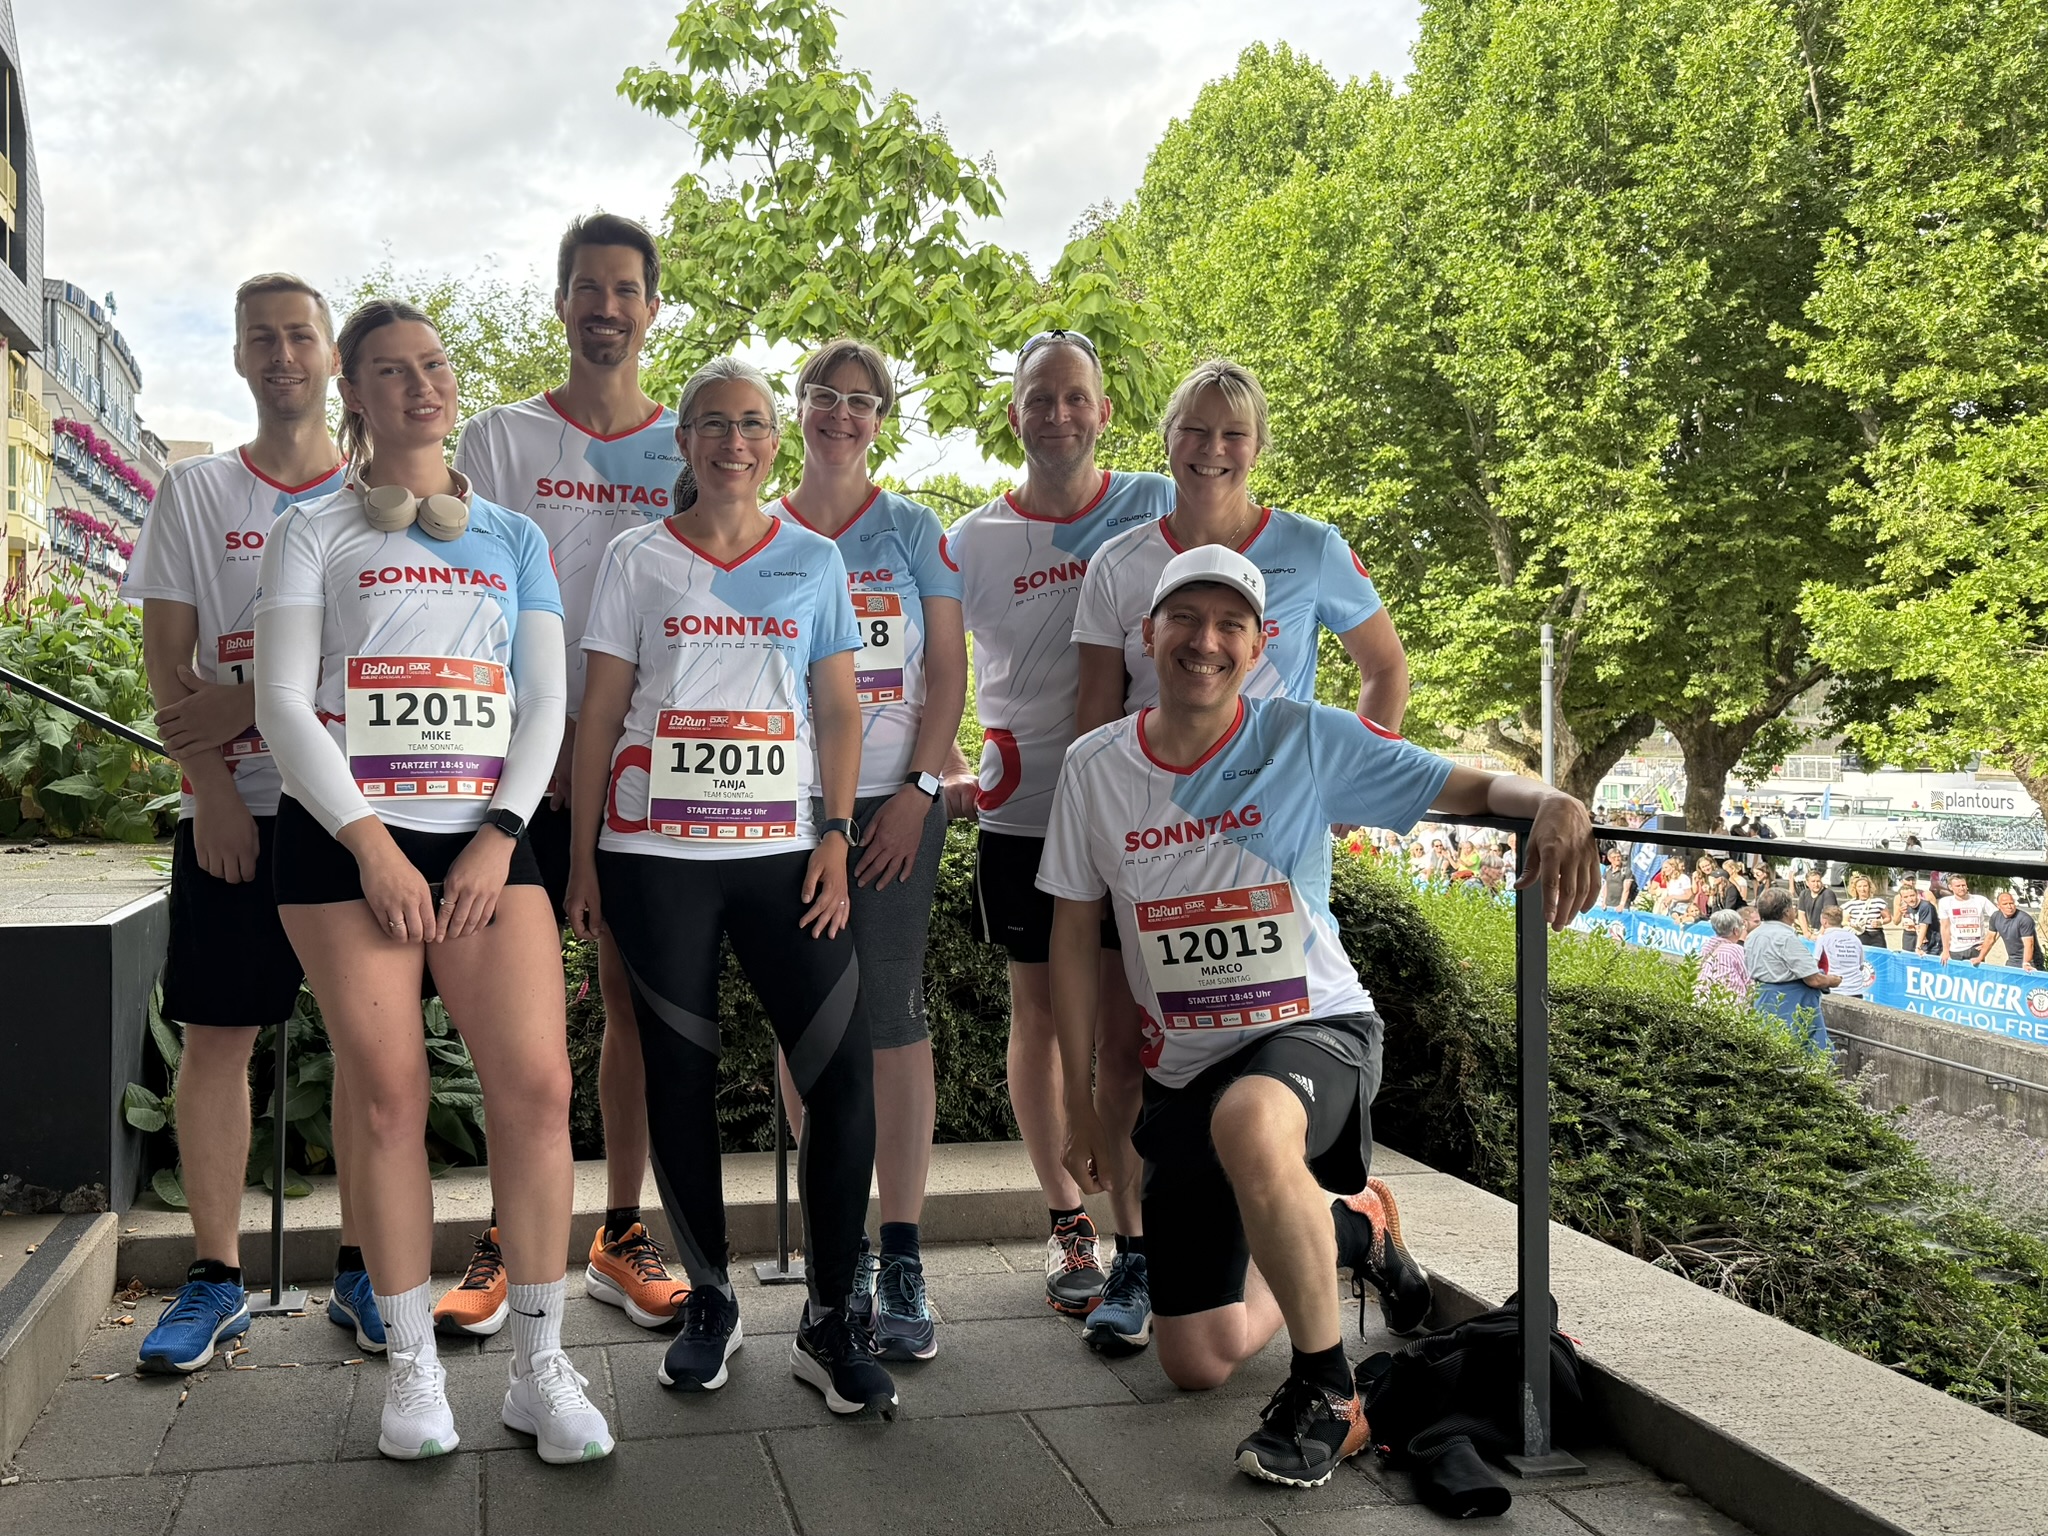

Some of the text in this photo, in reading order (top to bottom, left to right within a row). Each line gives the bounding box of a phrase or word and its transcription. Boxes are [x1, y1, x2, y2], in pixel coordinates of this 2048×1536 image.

[536, 477, 669, 508] SONNTAG
[358, 566, 508, 592] SONNTAG
[1013, 559, 1091, 595] SONN
[663, 615, 799, 639] SONNTAG
[361, 662, 405, 675] B2Run
[368, 692, 496, 729] 12015
[669, 715, 706, 727] B2Run
[421, 730, 452, 741] MIKE
[408, 743, 464, 751] TEAM SONNTAG
[390, 761, 480, 770] STARTZEIT 18:45 Uhr
[670, 742, 785, 776] 12010
[713, 779, 746, 791] TANJA
[703, 790, 754, 799] TEAM SONNTAG
[1945, 792, 2015, 811] plantours
[687, 806, 729, 815] STARTZEIT
[731, 807, 753, 816] 18:45
[1124, 804, 1263, 852] SONNTAG
[1147, 905, 1182, 919] B2Run
[1157, 920, 1283, 966] 12013
[1201, 962, 1243, 977] MARCO
[1198, 974, 1251, 987] TEAM SONNTAG
[1187, 994, 1227, 1005] STARTZEIT
[1229, 991, 1254, 1002] 18:45
[1255, 989, 1271, 998] Uhr
[1906, 965, 2026, 1017] ERDINGER
[1905, 1000, 2048, 1041] ALKOHOLFRE
